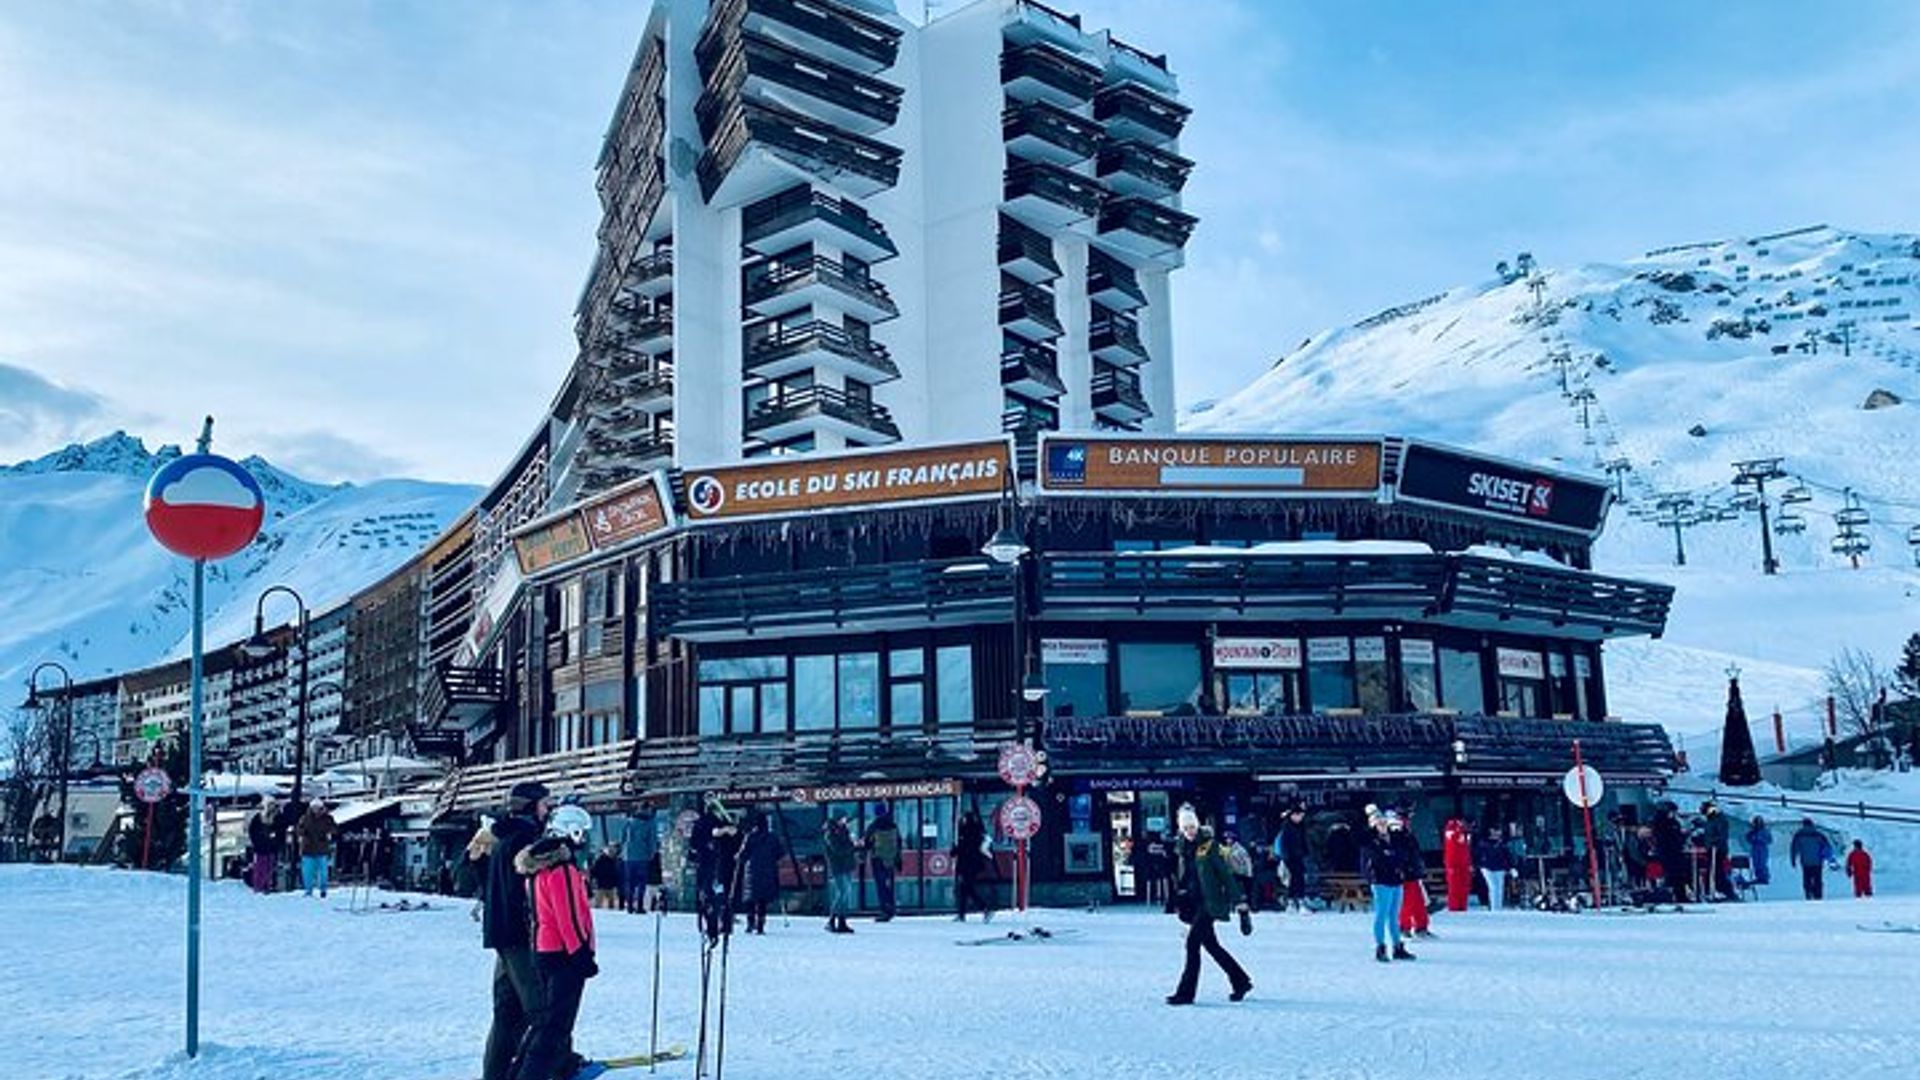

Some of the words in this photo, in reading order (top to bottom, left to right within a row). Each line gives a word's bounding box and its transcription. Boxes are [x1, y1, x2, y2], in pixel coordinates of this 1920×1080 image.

[1109, 447, 1210, 466] BANQUE
[1224, 448, 1358, 465] POPULAIRE
[735, 478, 800, 500] ECOLE
[806, 474, 838, 494] DU
[843, 471, 880, 490] SKI
[886, 458, 999, 486] FRANÇAIS
[1467, 472, 1533, 504] SKISET
[815, 787, 851, 800] ECOLE
[854, 788, 871, 798] DU
